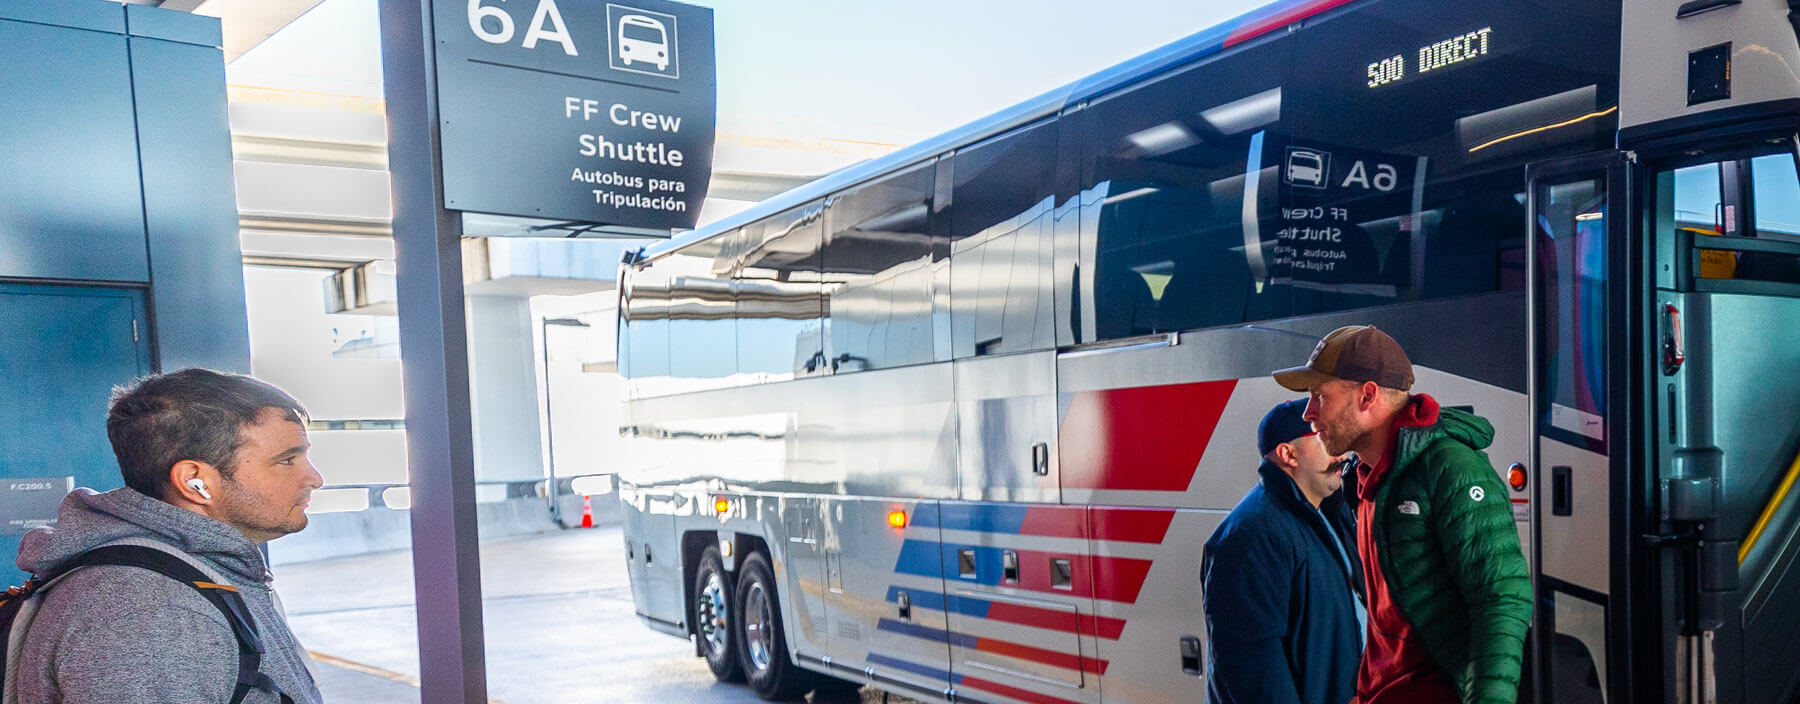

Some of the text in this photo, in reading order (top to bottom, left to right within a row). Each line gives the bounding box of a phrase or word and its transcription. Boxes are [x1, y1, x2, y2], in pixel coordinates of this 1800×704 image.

[467, 0, 579, 56] 6A
[1367, 26, 1492, 88] 500 DIRECT
[565, 97, 681, 132] FF Crew
[579, 134, 684, 167] Shuttle
[571, 167, 685, 193] Autobus para
[592, 189, 686, 212] Tripulación
